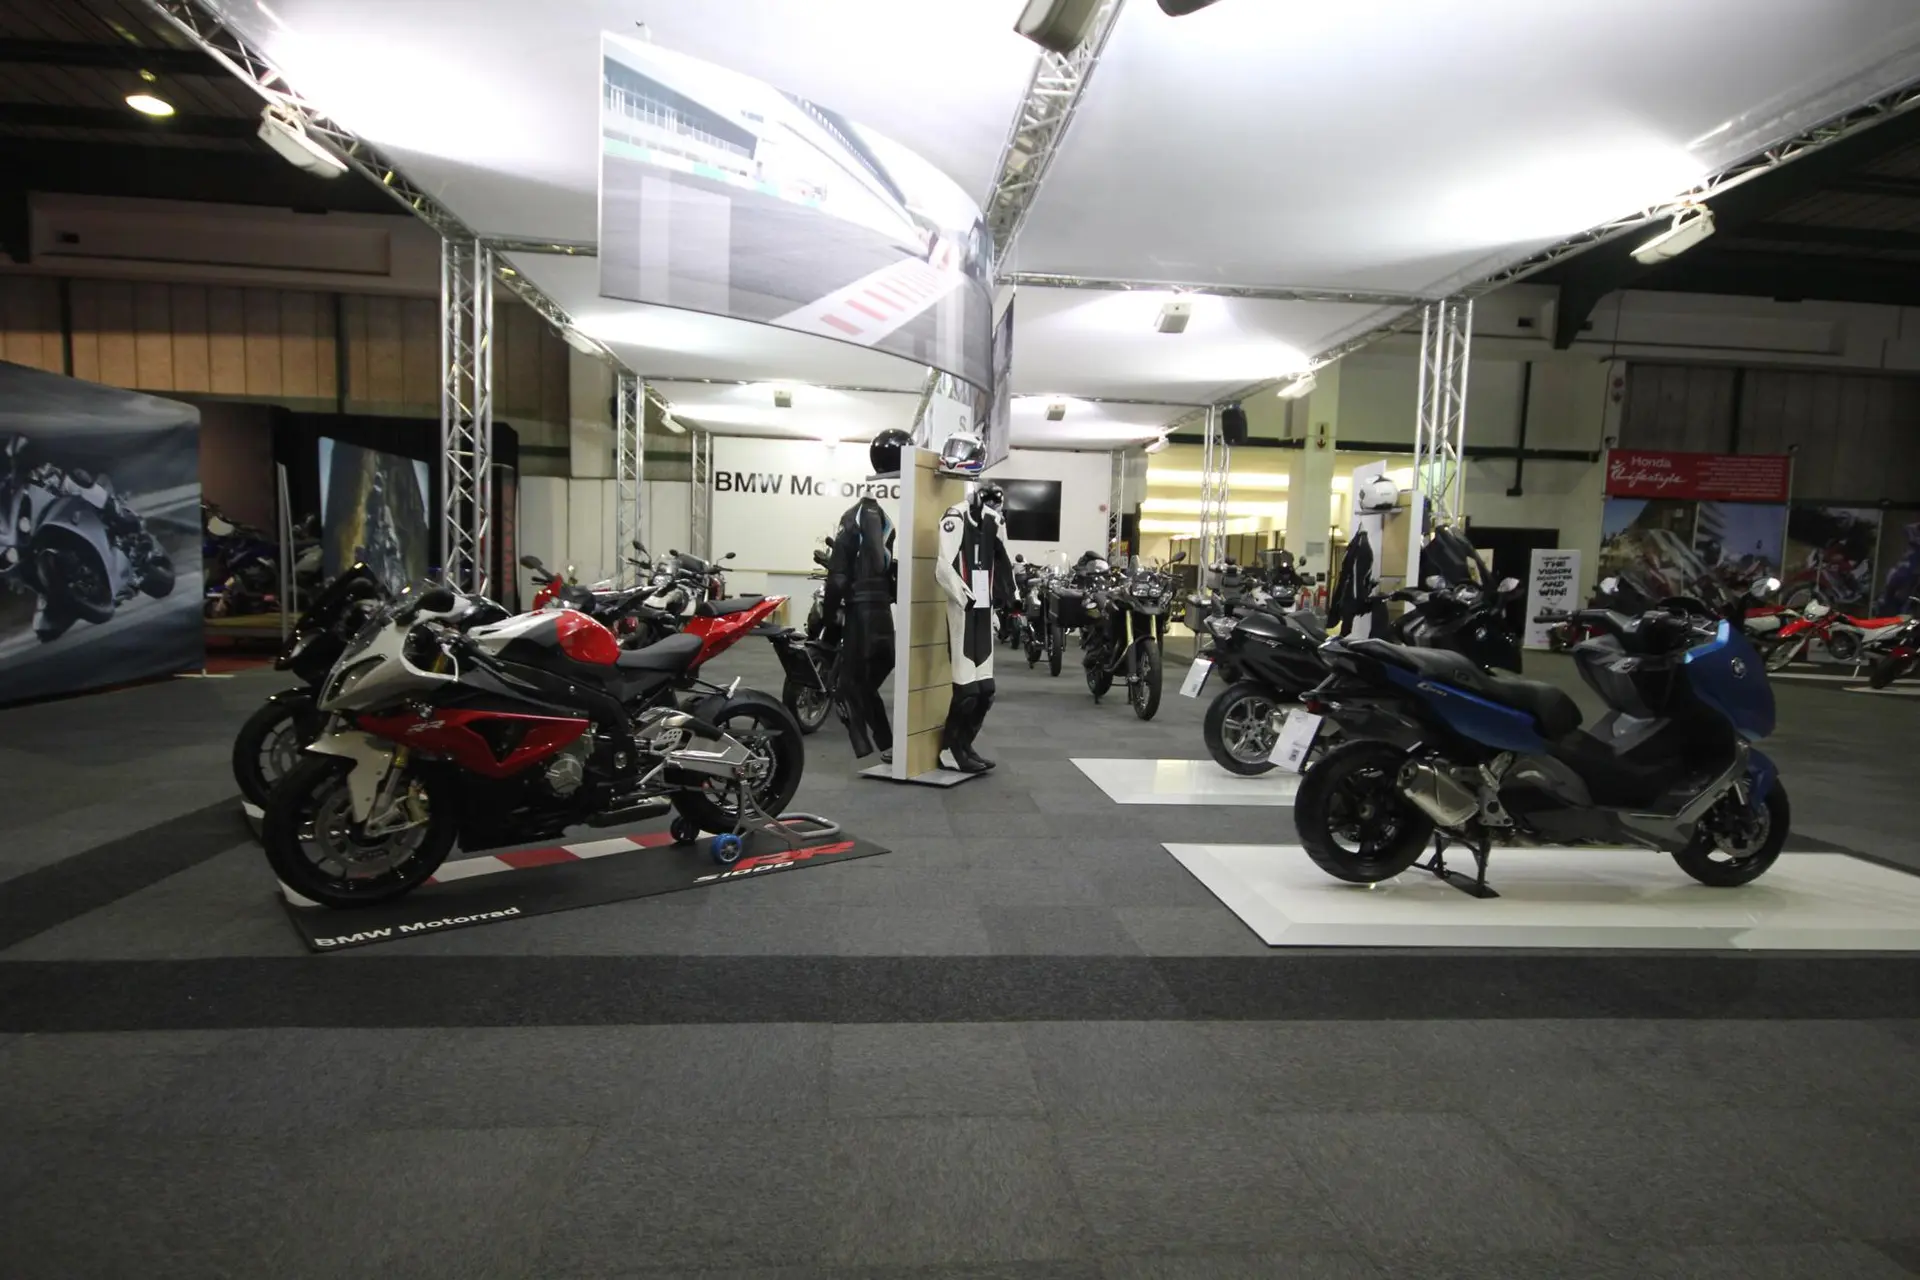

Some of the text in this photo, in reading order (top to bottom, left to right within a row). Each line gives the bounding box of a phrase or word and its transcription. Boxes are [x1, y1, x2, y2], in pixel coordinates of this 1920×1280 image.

[1631, 456, 1672, 468] Honda
[715, 471, 783, 494] BMW
[1538, 587, 1567, 596] WIN!
[314, 906, 521, 947] BMW Motorrad
